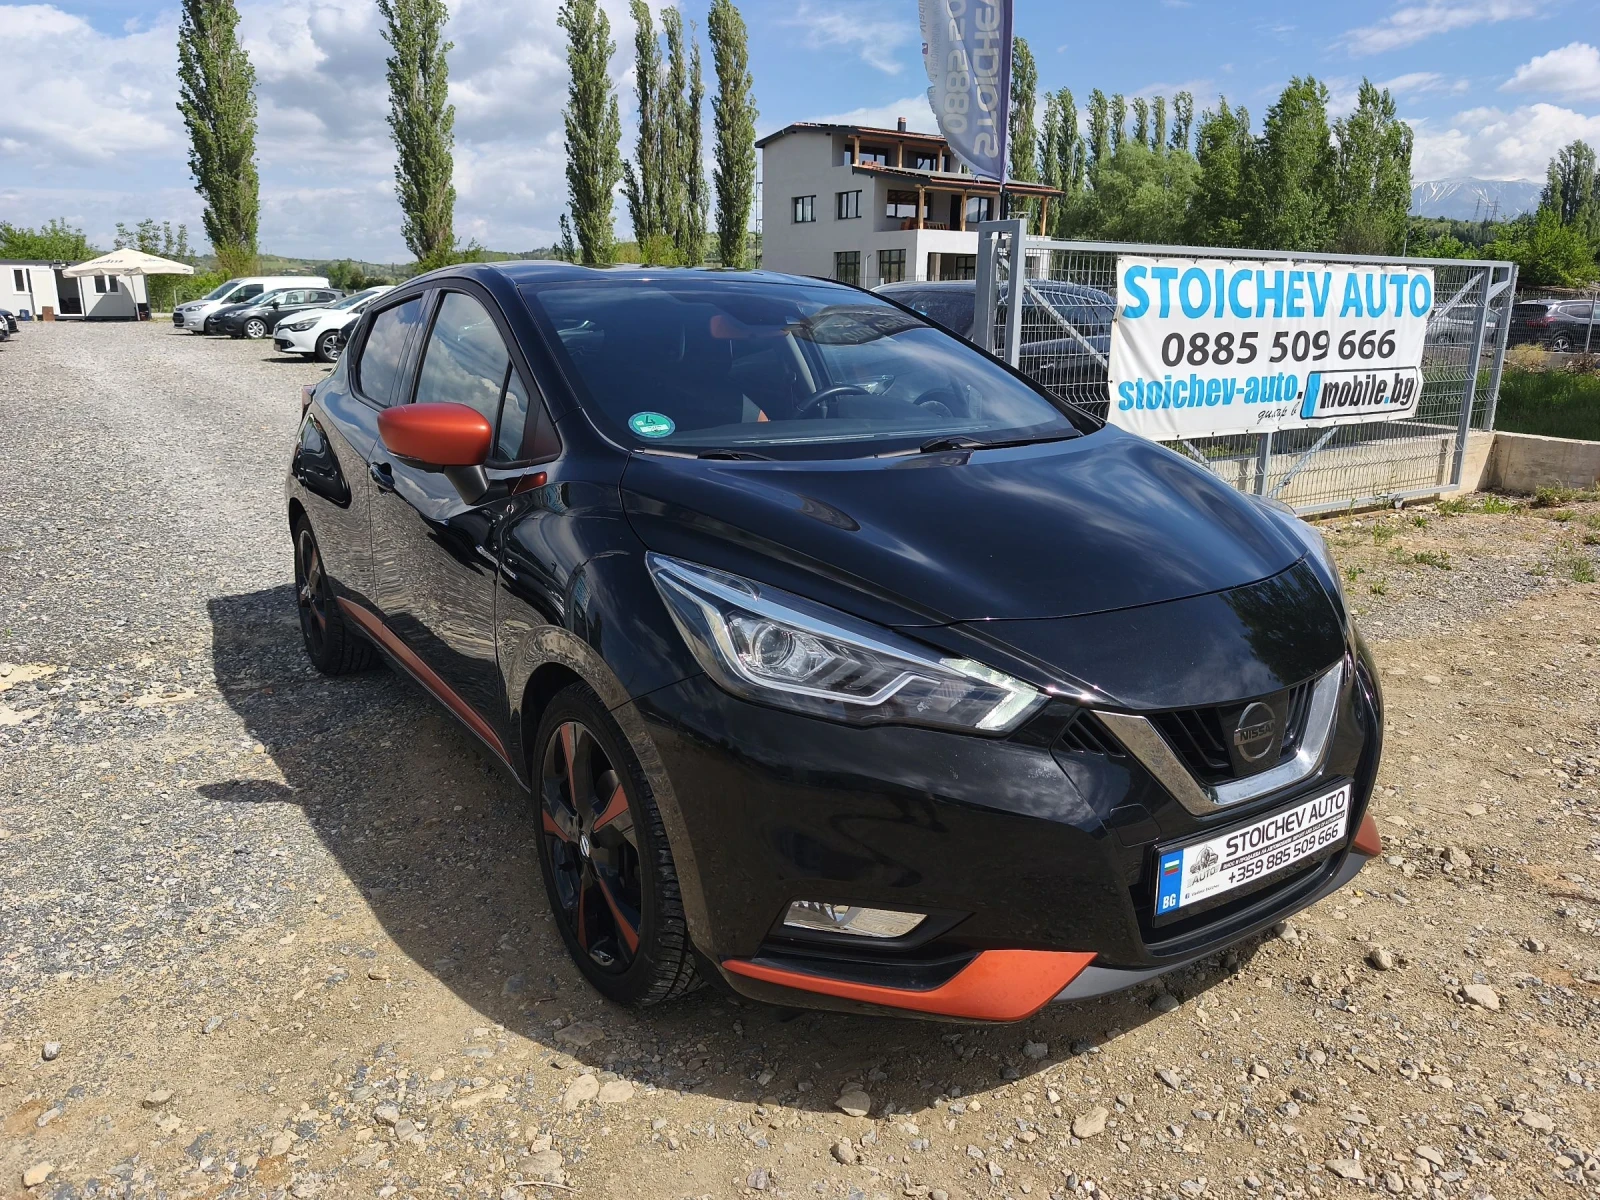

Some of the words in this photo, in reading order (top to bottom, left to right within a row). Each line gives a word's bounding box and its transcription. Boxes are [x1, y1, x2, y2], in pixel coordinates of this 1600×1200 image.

[1122, 265, 1332, 319] STOICHEV
[1339, 273, 1431, 318] AUTO
[1162, 331, 1258, 367] 0885
[1270, 330, 1330, 363] 509
[1338, 329, 1396, 360] 666
[1240, 722, 1275, 741] NISSAN
[1226, 808, 1306, 857] STOICHEV
[1309, 791, 1345, 823] AUTO
[1228, 859, 1264, 884] +359
[1266, 847, 1291, 870] 885
[1293, 835, 1316, 858] 509
[1318, 823, 1338, 845] 666
[1162, 893, 1176, 909] BG
